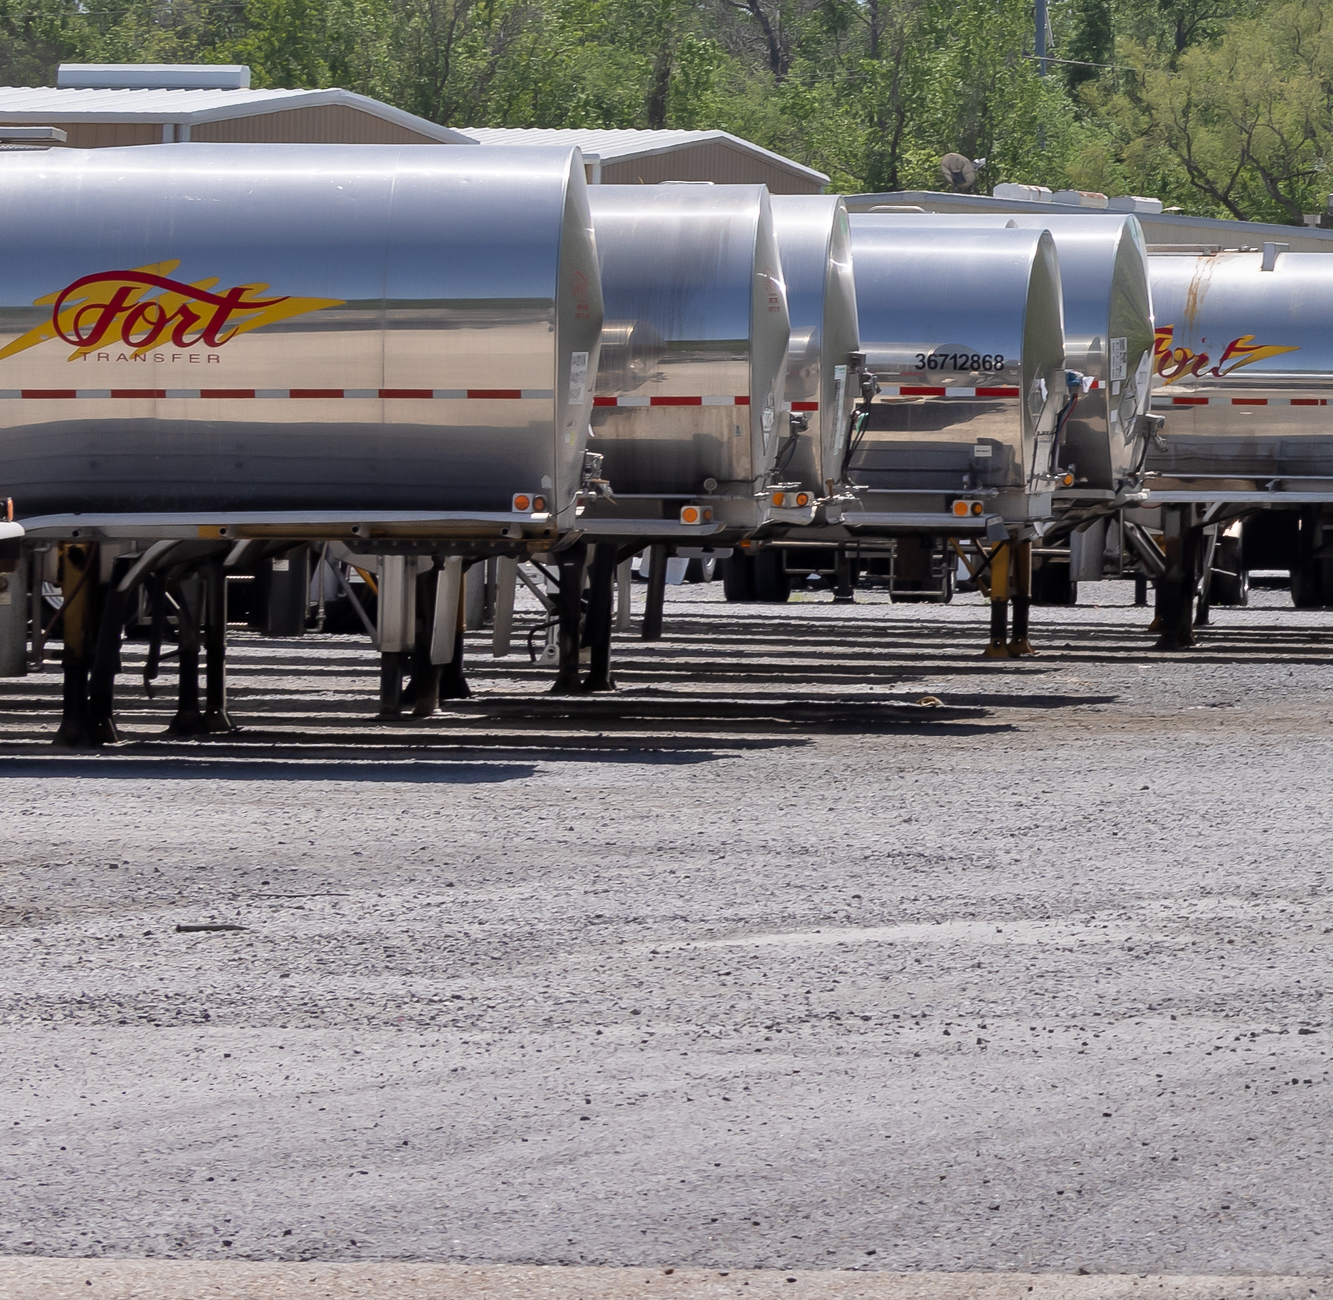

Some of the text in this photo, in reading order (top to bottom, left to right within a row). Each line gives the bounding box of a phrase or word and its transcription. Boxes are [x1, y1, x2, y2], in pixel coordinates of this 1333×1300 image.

[52, 270, 291, 348] Fort
[80, 352, 220, 364] TRANSFER
[914, 353, 1005, 371] 36712868
[1154, 328, 1268, 378] ort
